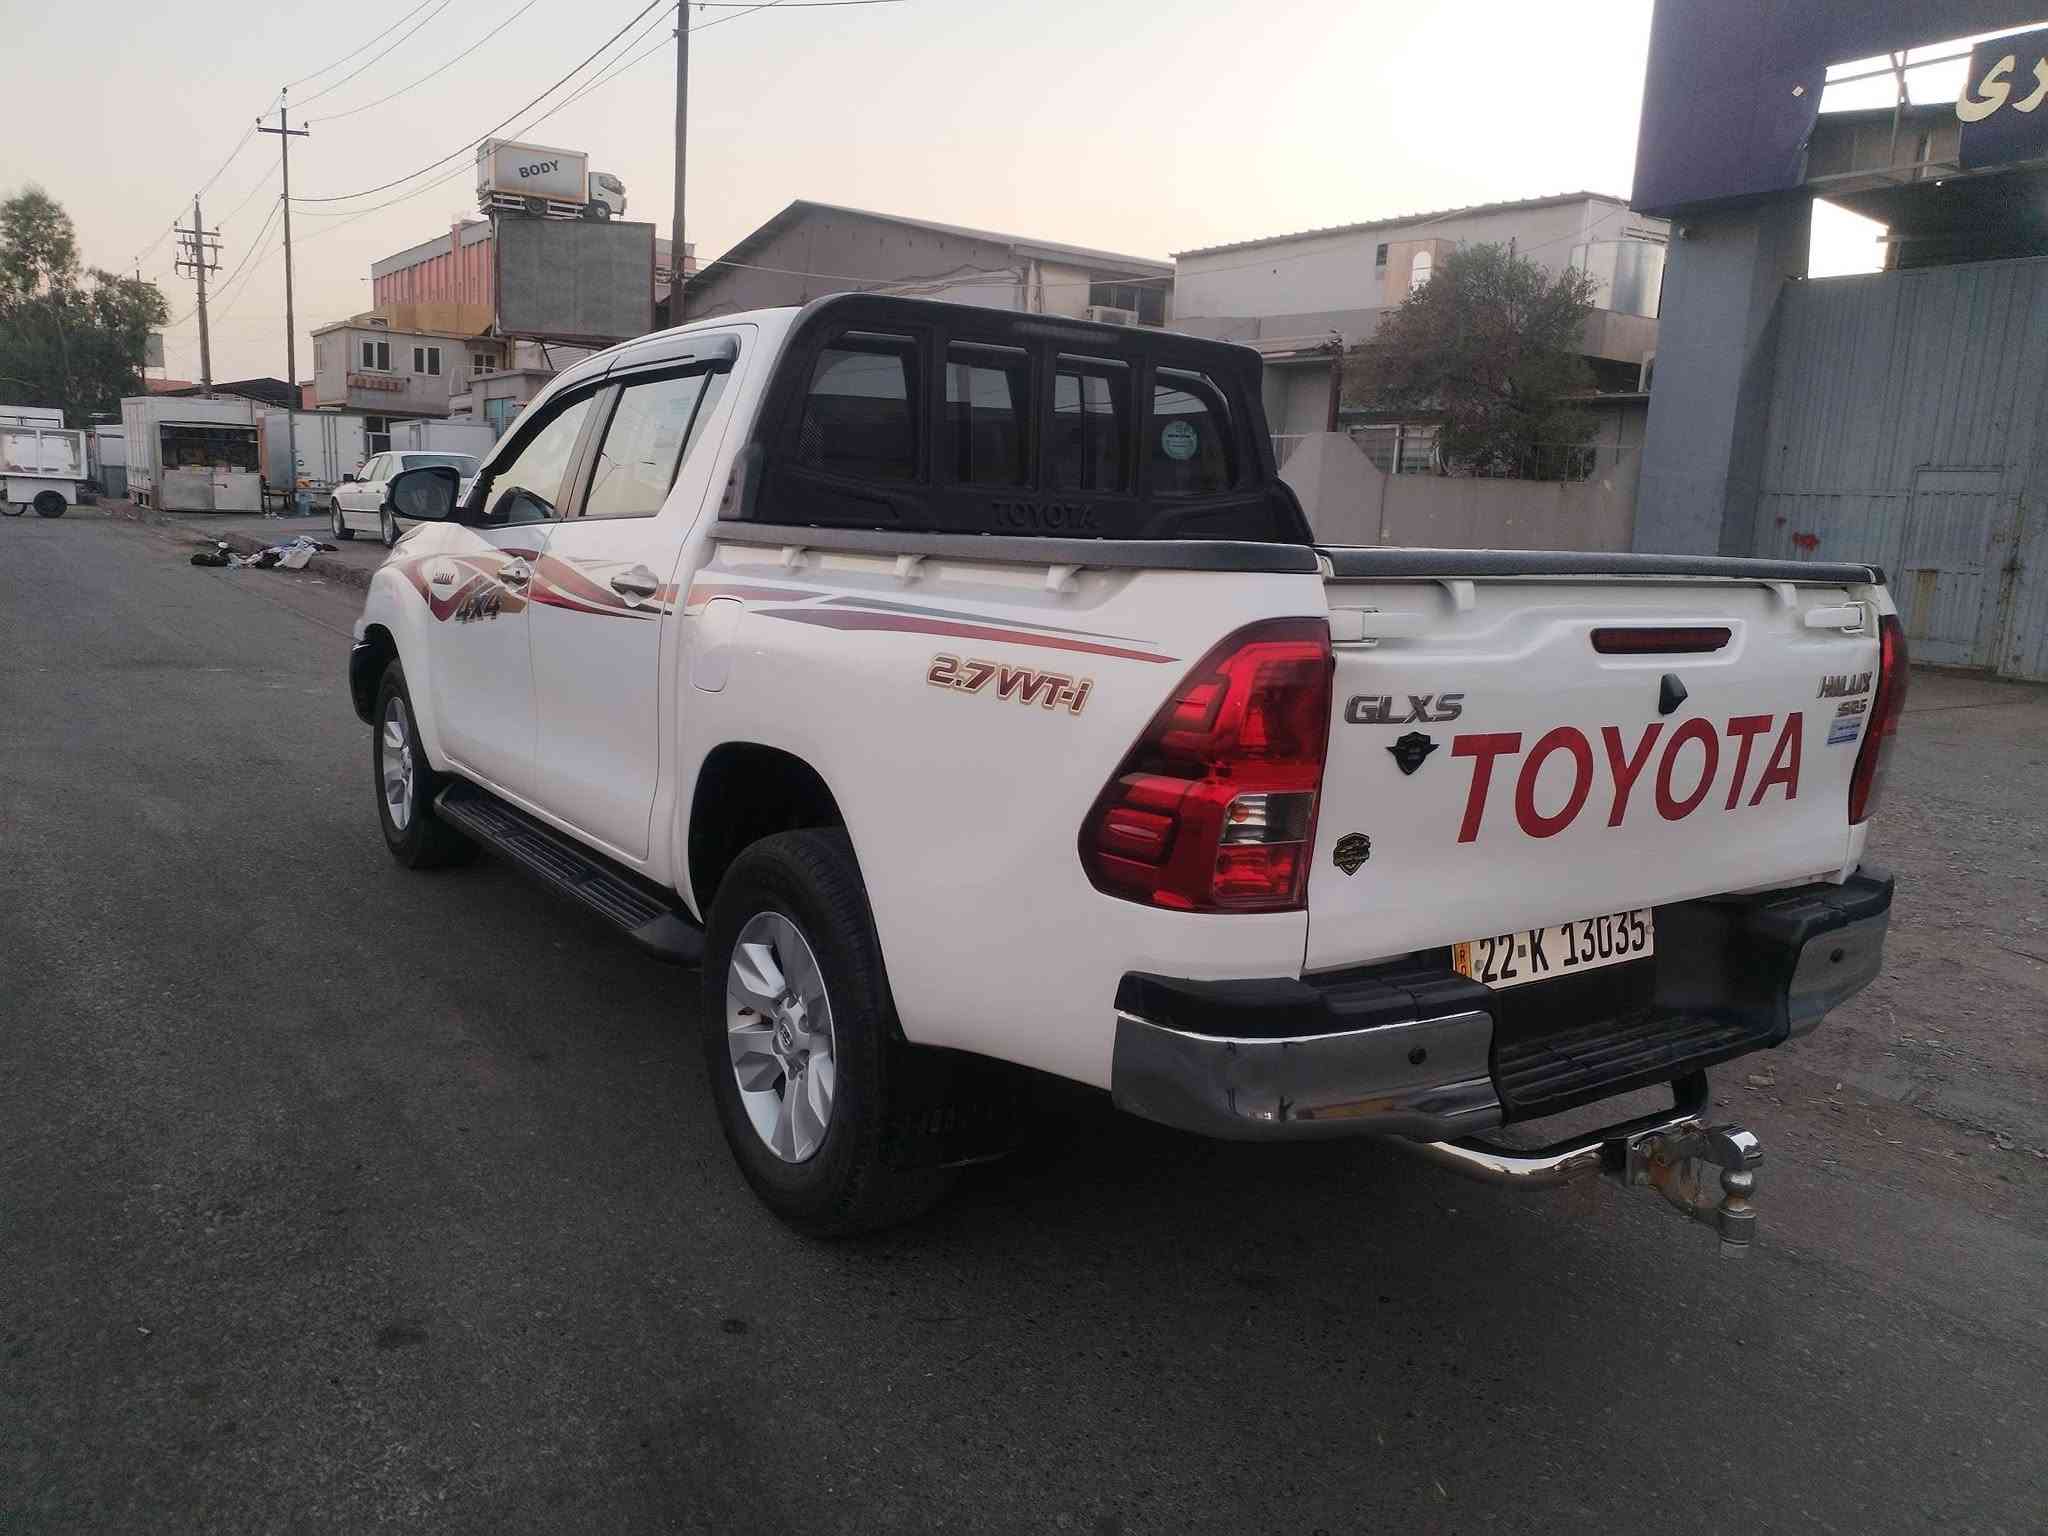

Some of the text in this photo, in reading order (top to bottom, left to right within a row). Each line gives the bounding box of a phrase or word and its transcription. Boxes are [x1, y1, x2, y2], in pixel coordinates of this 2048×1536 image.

[519, 160, 559, 178] BODY
[992, 503, 1104, 529] TOYOTA
[1344, 693, 1465, 724] GLXS
[1451, 711, 1803, 844] TOYOTA
[1561, 909, 1646, 967] 13035
